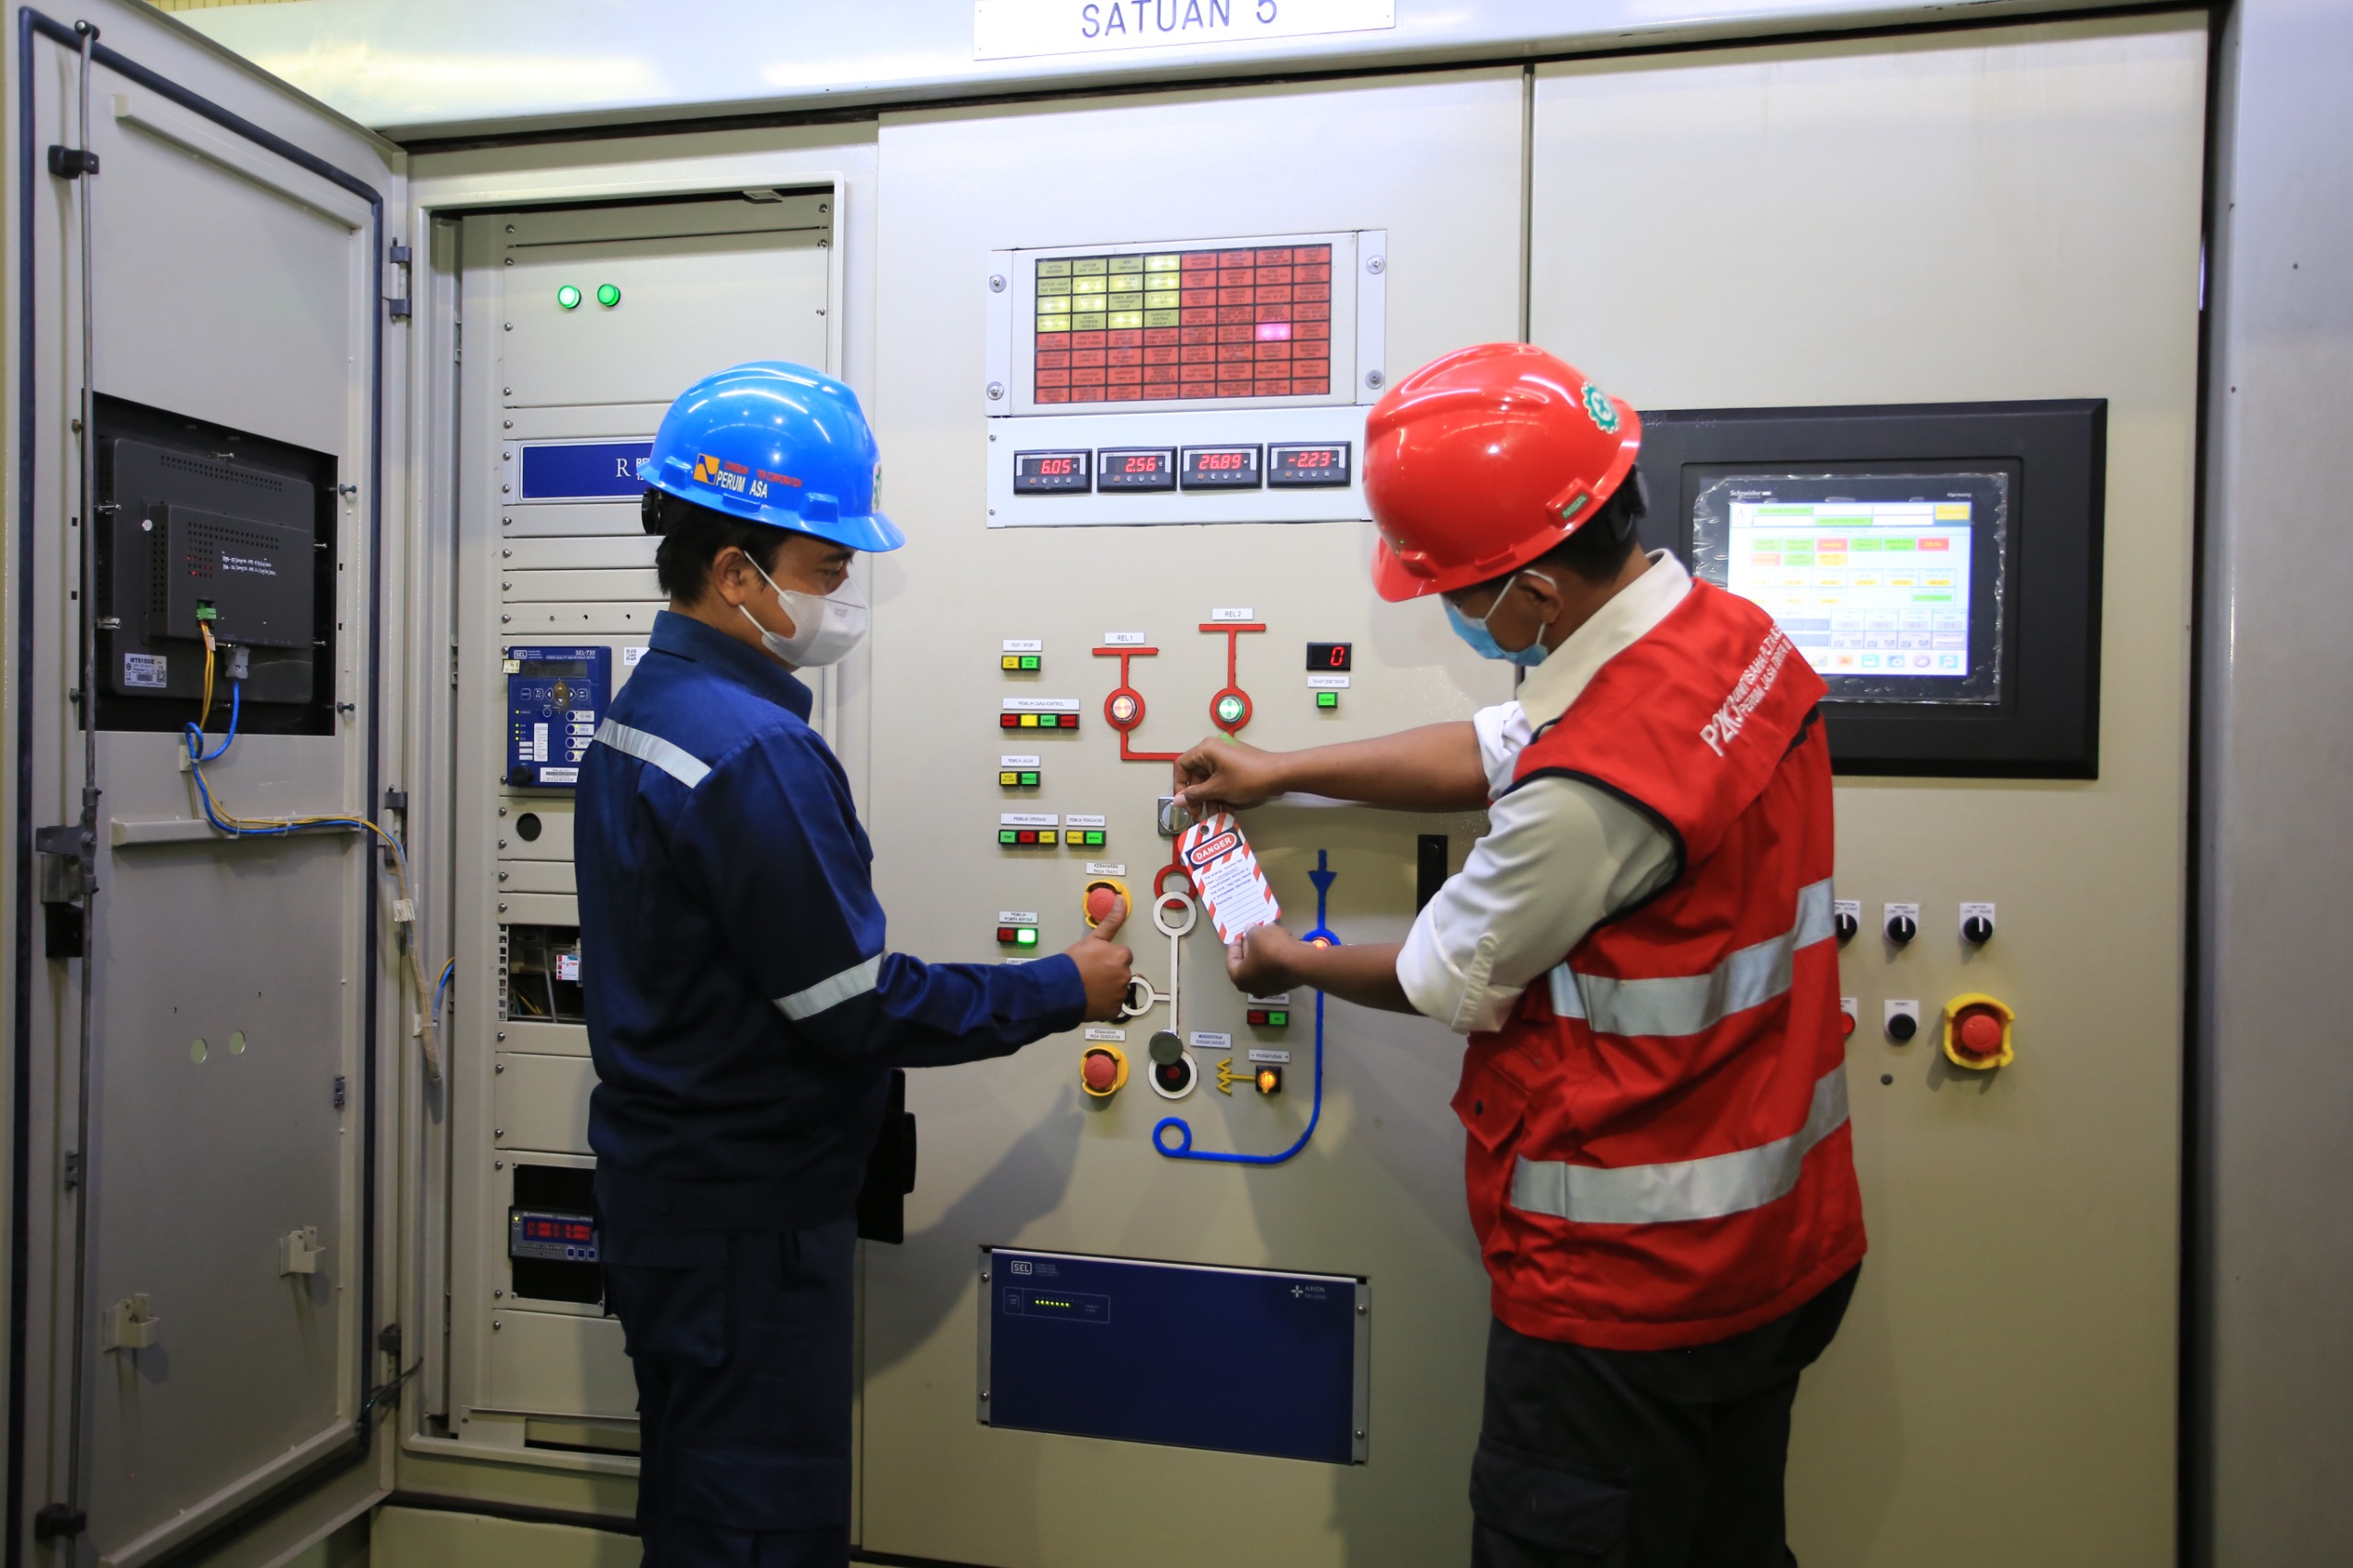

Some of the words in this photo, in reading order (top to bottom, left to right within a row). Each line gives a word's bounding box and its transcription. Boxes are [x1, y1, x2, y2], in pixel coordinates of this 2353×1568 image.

[1081, 0, 1230, 39] SATUAN
[1256, 0, 1279, 24] 5
[616, 458, 631, 478] R
[1040, 459, 1072, 474] 6.05
[1125, 457, 1157, 473] 2.56
[1199, 454, 1243, 470] 26.89
[716, 470, 746, 493] PERUM
[749, 479, 768, 499] ASA
[1330, 647, 1345, 666] 0
[1699, 695, 1744, 757] P2K3
[1196, 837, 1231, 859] DANGER
[1014, 1264, 1029, 1273] SEL
